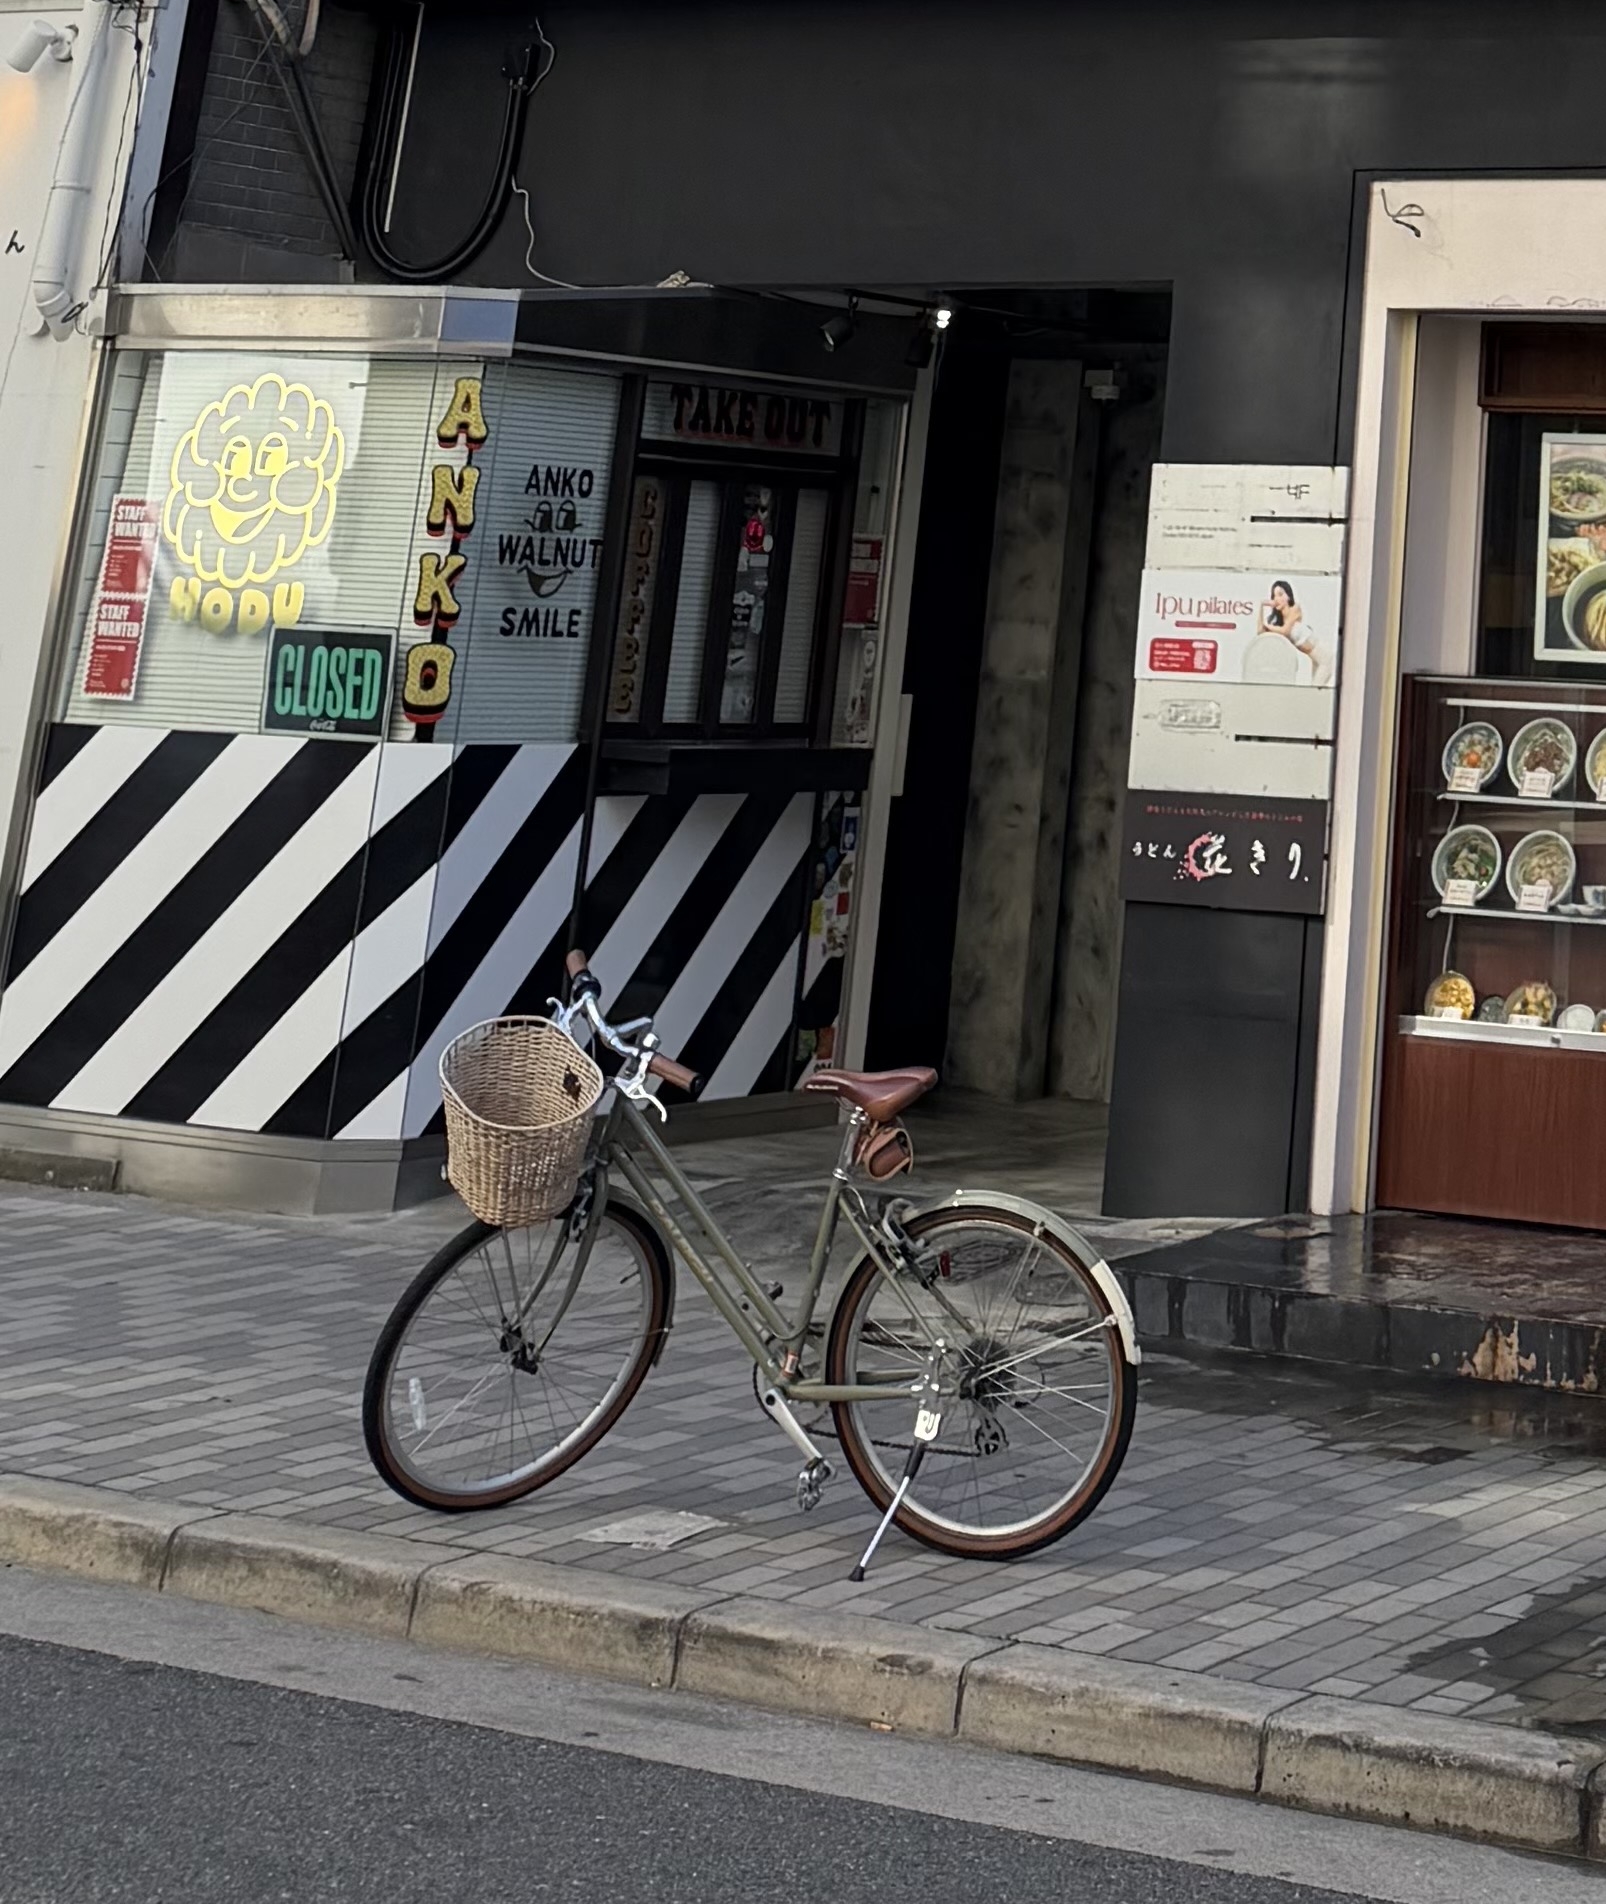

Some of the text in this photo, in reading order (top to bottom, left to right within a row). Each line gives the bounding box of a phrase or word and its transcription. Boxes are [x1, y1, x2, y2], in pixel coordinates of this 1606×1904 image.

[671, 383, 831, 447] TAKE OUT
[524, 464, 594, 499] ANKO
[117, 505, 146, 522] STAFF
[402, 376, 490, 724] ANKO
[499, 534, 603, 569] WALNUT
[99, 604, 131, 621] STAFF
[169, 576, 305, 635] HODU
[500, 607, 582, 639] SMILE
[1196, 595, 1254, 618] pilates
[97, 620, 140, 639] WANTED
[273, 643, 383, 720] CLOSED
[1202, 834, 1302, 880] 花きり
